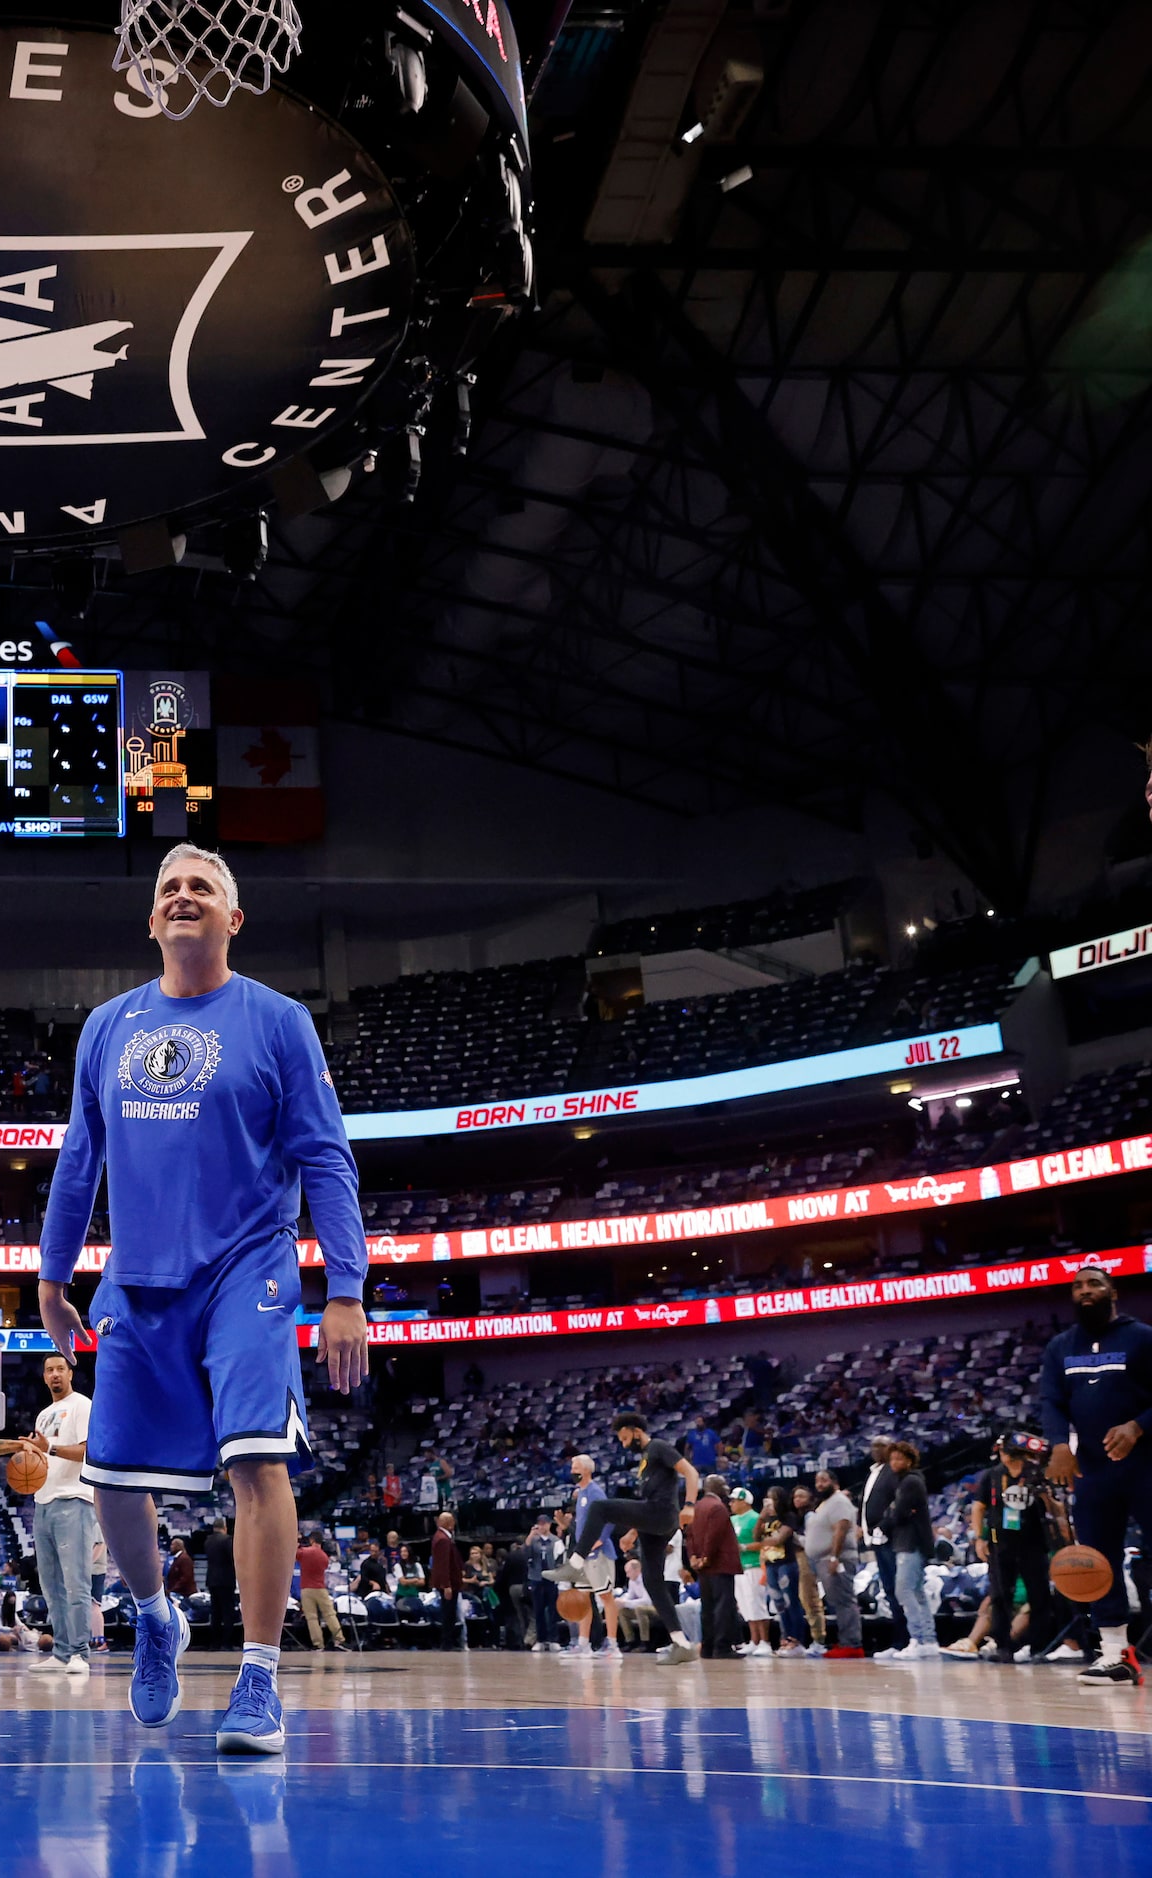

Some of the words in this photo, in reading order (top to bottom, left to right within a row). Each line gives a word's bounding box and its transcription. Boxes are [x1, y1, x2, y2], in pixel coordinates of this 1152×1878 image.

[51, 695, 72, 704] DAL
[83, 695, 109, 704] GSW
[14, 788, 30, 797] FTs
[1078, 927, 1152, 969] DILJI
[133, 1030, 168, 1060] NATIONAL
[171, 1028, 204, 1062] BASKETBALL
[905, 1041, 935, 1065] JUL
[939, 1036, 961, 1060] 22
[138, 1077, 188, 1095] ASSOCIATION
[121, 1100, 201, 1120] MAVERICKS
[456, 1104, 526, 1129] BORN
[533, 1106, 556, 1120] TO
[562, 1090, 639, 1117] SHINE
[1042, 1144, 1121, 1185] CLEAN.
[490, 1225, 559, 1253] CLEAN.
[561, 1215, 654, 1248] HEALTHY.
[656, 1202, 774, 1240] HYDRATION.
[788, 1193, 841, 1221] NOW
[843, 1190, 871, 1214] AT
[757, 1293, 810, 1315] CLEAN.
[811, 1283, 882, 1310] HEALTHY.
[882, 1273, 977, 1302] HYDRATION.
[986, 1267, 1025, 1288] NOW
[1030, 1264, 1050, 1282] AT
[410, 1321, 473, 1342] HEALTHY.
[475, 1313, 558, 1338] HYDRATION.
[567, 1312, 604, 1330] NOW
[605, 1311, 624, 1327] AT
[20, 1339, 28, 1348] 0
